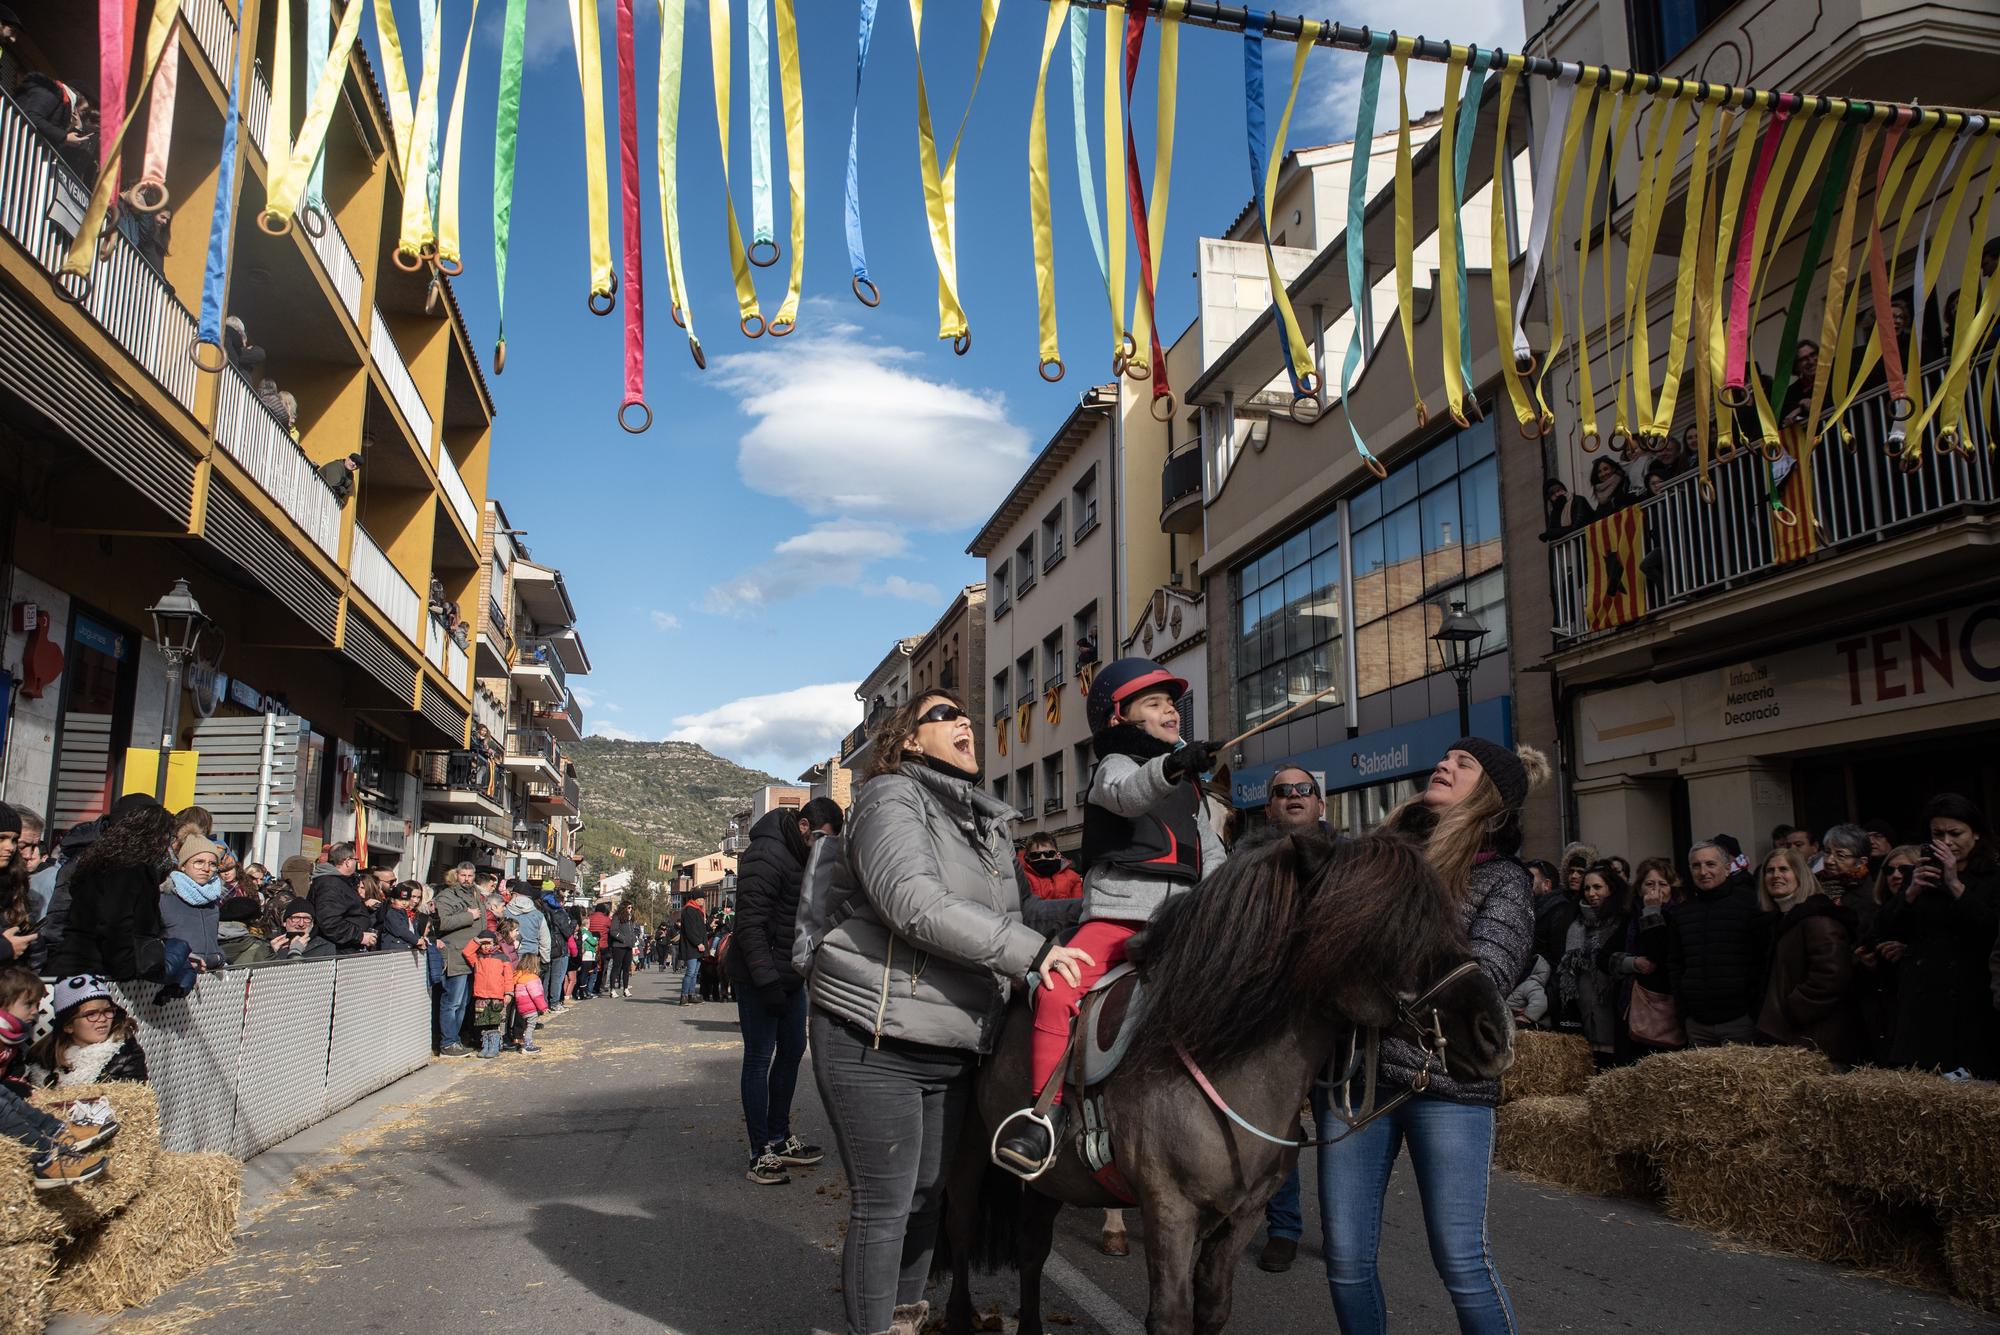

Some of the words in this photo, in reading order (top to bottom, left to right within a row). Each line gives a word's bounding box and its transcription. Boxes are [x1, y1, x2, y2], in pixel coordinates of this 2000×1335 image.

[1729, 664, 1768, 686] Infantil
[1726, 685, 1775, 706] Merceria
[1724, 702, 1780, 726] Decoració
[1359, 743, 1409, 776] Sabadell
